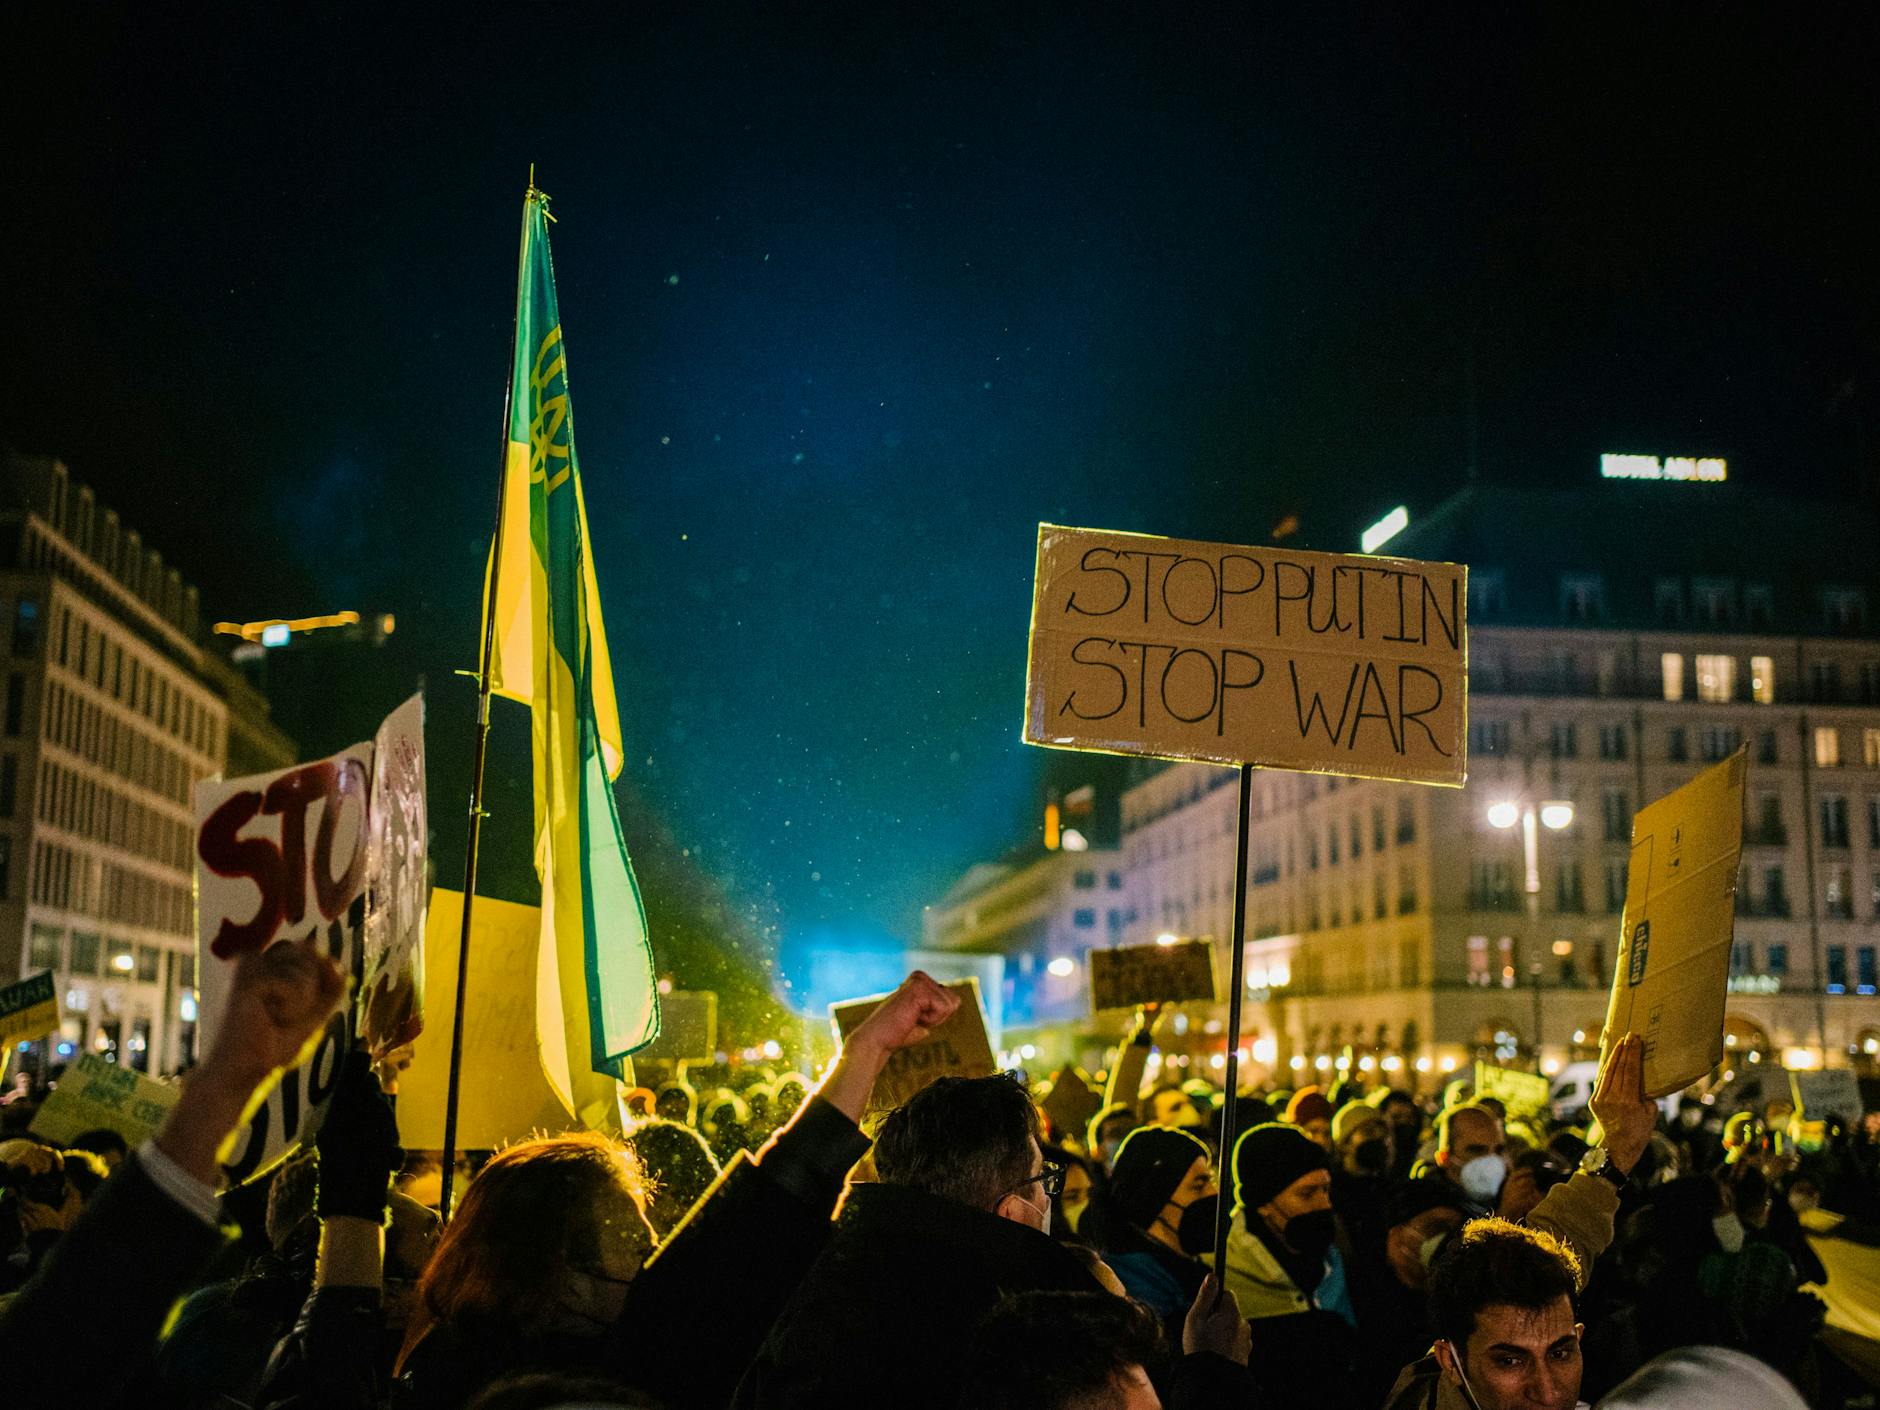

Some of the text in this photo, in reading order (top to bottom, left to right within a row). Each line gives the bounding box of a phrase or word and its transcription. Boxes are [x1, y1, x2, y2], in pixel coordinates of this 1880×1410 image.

[1065, 548, 1459, 650] STOP PUTIN
[1059, 637, 1452, 757] STOP WAR
[1632, 927, 1648, 984] chicco
